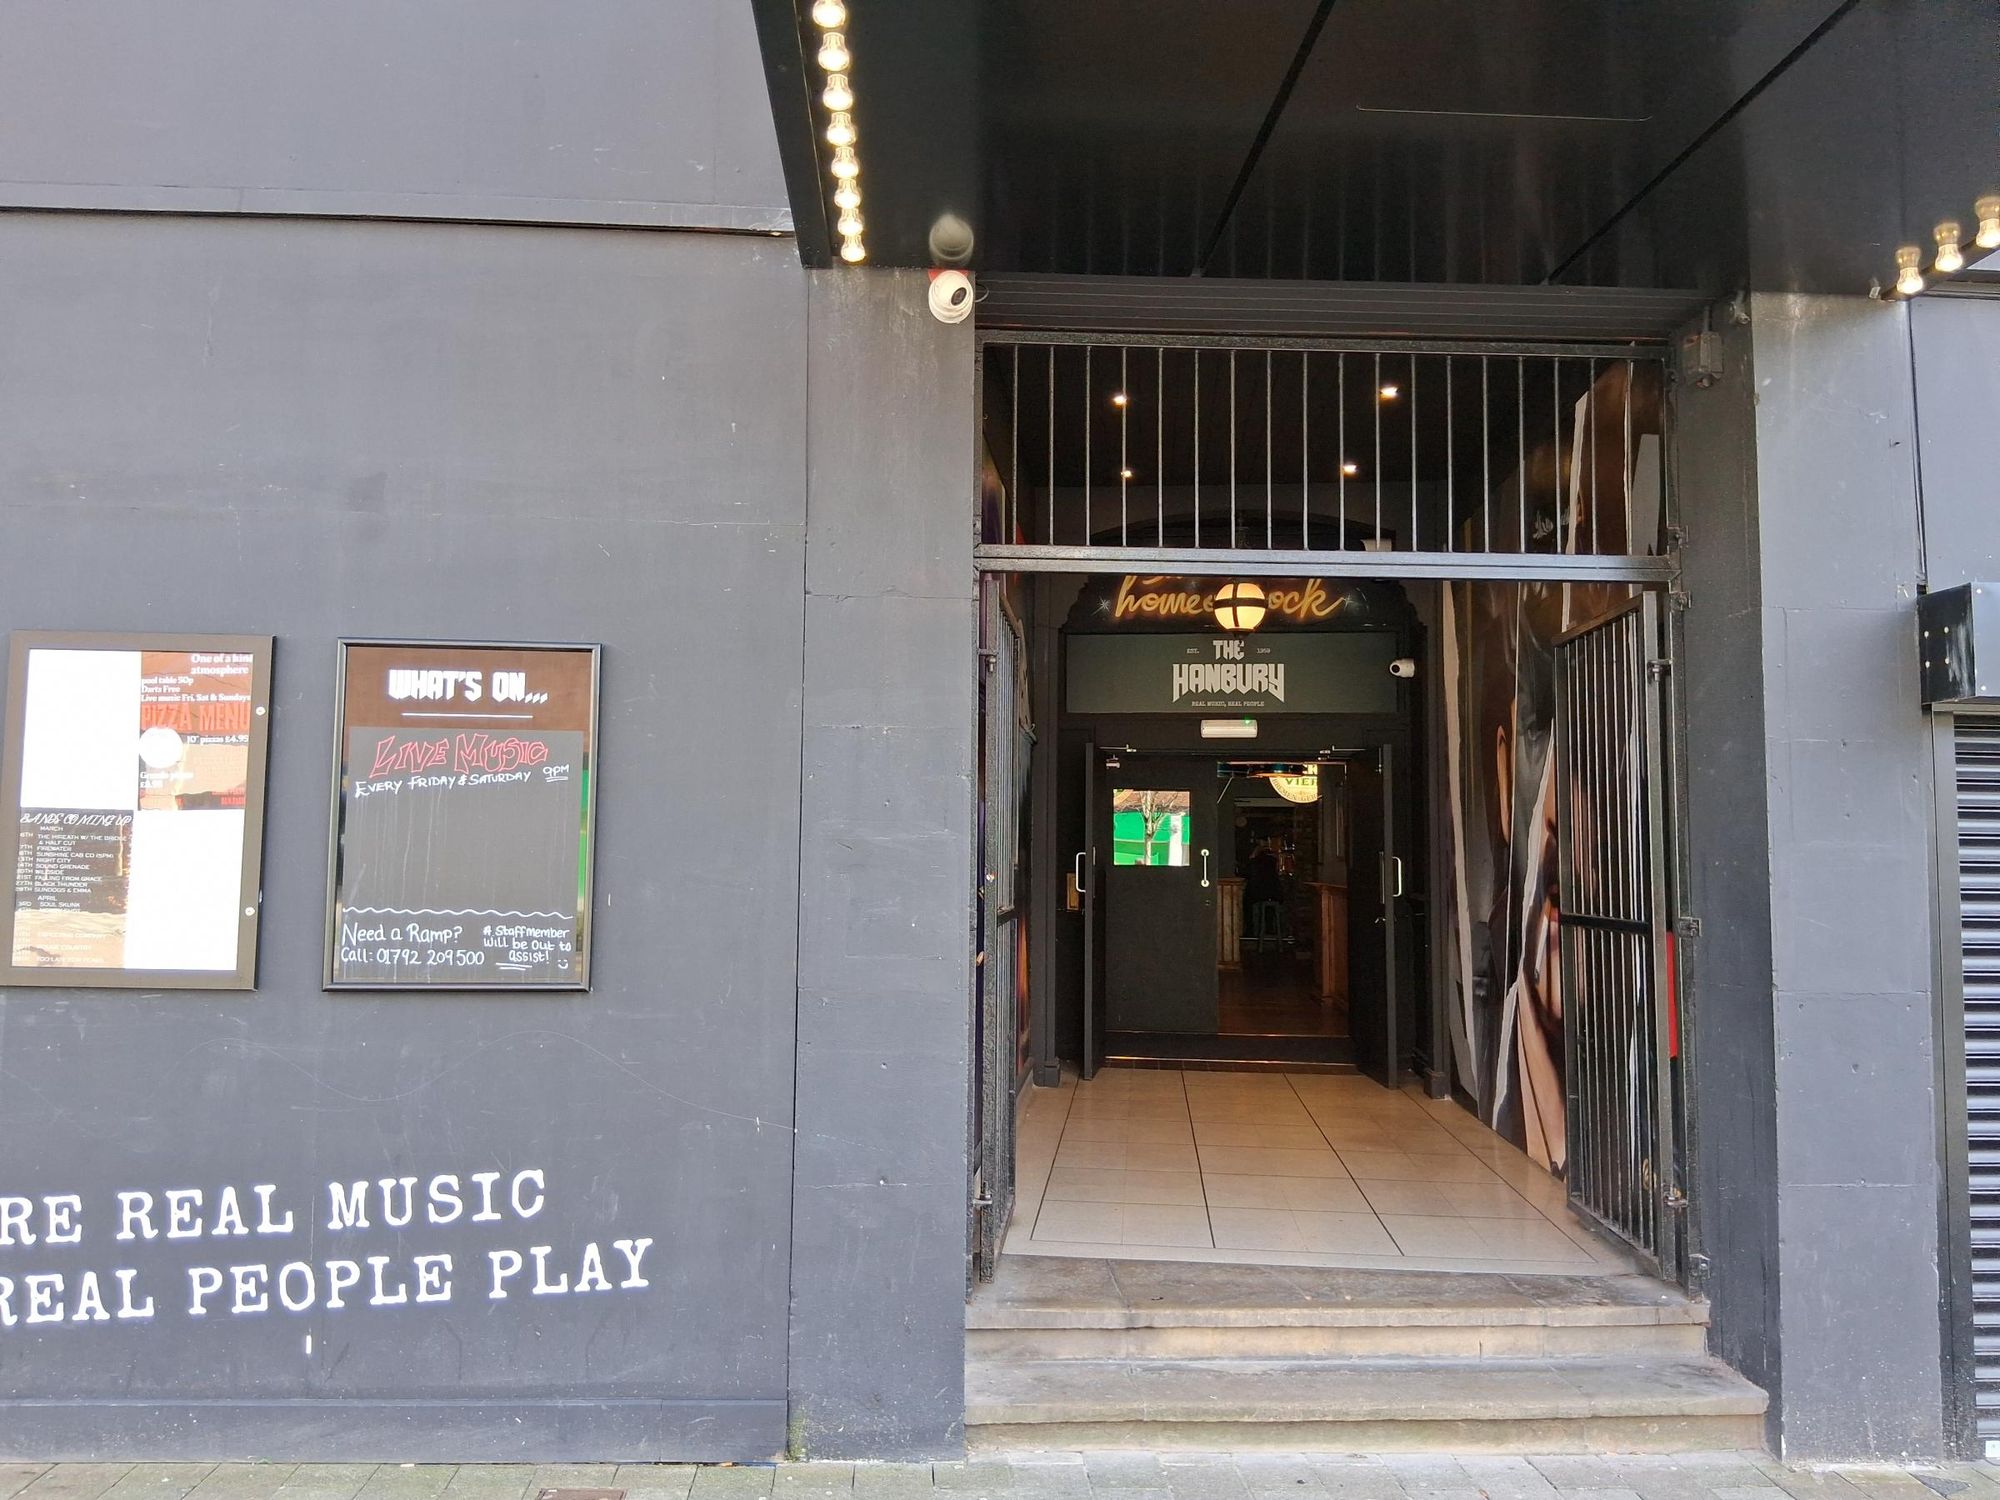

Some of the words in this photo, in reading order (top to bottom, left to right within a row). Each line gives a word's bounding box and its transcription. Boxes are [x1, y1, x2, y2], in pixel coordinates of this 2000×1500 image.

[1267, 578, 1344, 618] ock
[191, 654, 212, 663] One
[213, 653, 224, 663] of
[1213, 640, 1245, 660] THE
[191, 665, 249, 677] atmosphere
[1172, 664, 1285, 702] HANBURY
[142, 685, 162, 694] Darts
[163, 685, 180, 693] Free
[389, 669, 482, 702] WHAT'S
[142, 694, 158, 702] Live
[142, 702, 193, 730] PIZZA
[200, 702, 250, 731] MENU
[369, 735, 449, 778] LIVE
[454, 733, 549, 775] MUSIC
[355, 780, 402, 798] EVERY
[407, 774, 455, 790] FRIDAY
[467, 770, 531, 786] SATURDAY
[20, 813, 64, 825] BANDS
[115, 814, 133, 826] UP
[342, 922, 387, 946] Need
[391, 927, 403, 940] a
[406, 922, 463, 945] Ramp?
[512, 937, 529, 950] be
[559, 941, 572, 952] to
[376, 947, 422, 966] 01792
[116, 1184, 294, 1240] REAL
[327, 1168, 545, 1230] MUSIC
[188, 1253, 453, 1315] PEOPLE
[489, 1238, 653, 1299] PLAY
